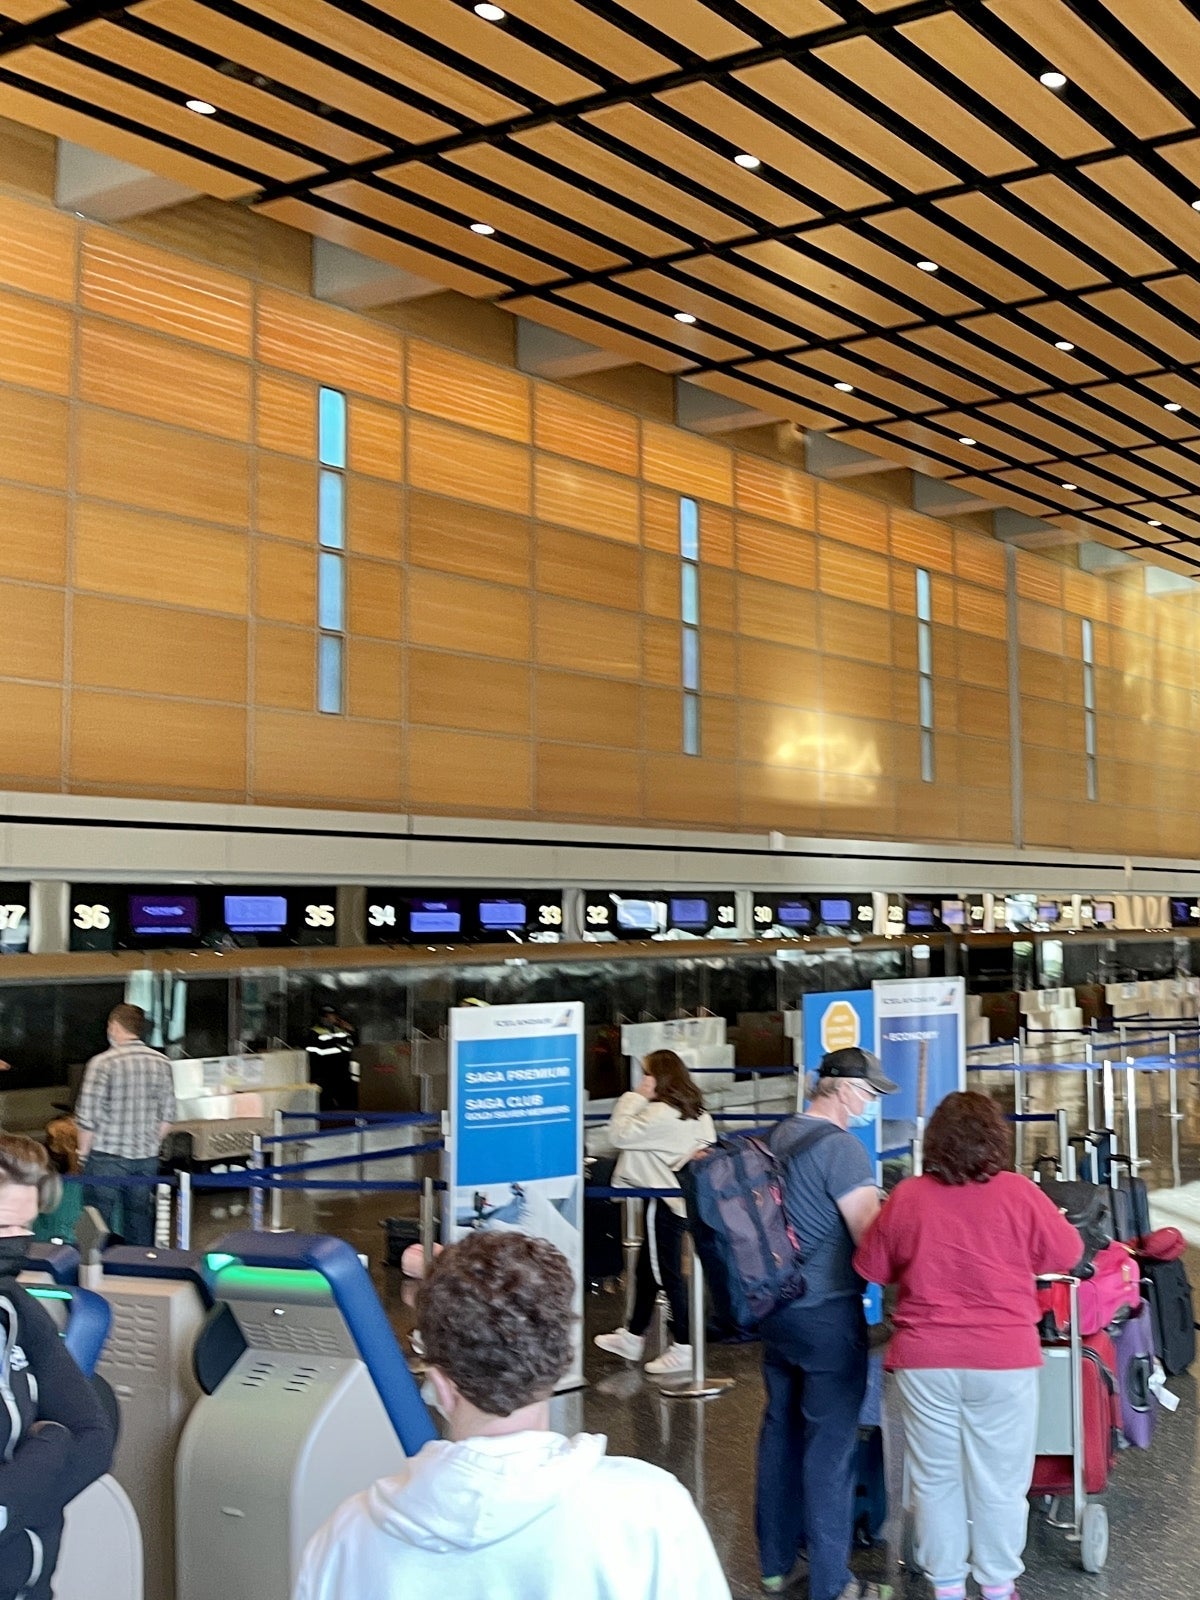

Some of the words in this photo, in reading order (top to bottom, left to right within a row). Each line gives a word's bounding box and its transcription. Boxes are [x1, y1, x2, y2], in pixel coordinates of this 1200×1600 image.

[73, 904, 111, 930] 36
[304, 904, 336, 928] 35
[368, 904, 397, 927] 34
[538, 904, 562, 925] 33
[586, 905, 609, 925] 32
[717, 905, 735, 923] 31
[754, 905, 773, 923] 30
[464, 1071, 506, 1084] SAGA
[506, 1066, 571, 1081] PREMIUM
[464, 1097, 506, 1110] SAGA
[505, 1094, 544, 1108] CLUB
